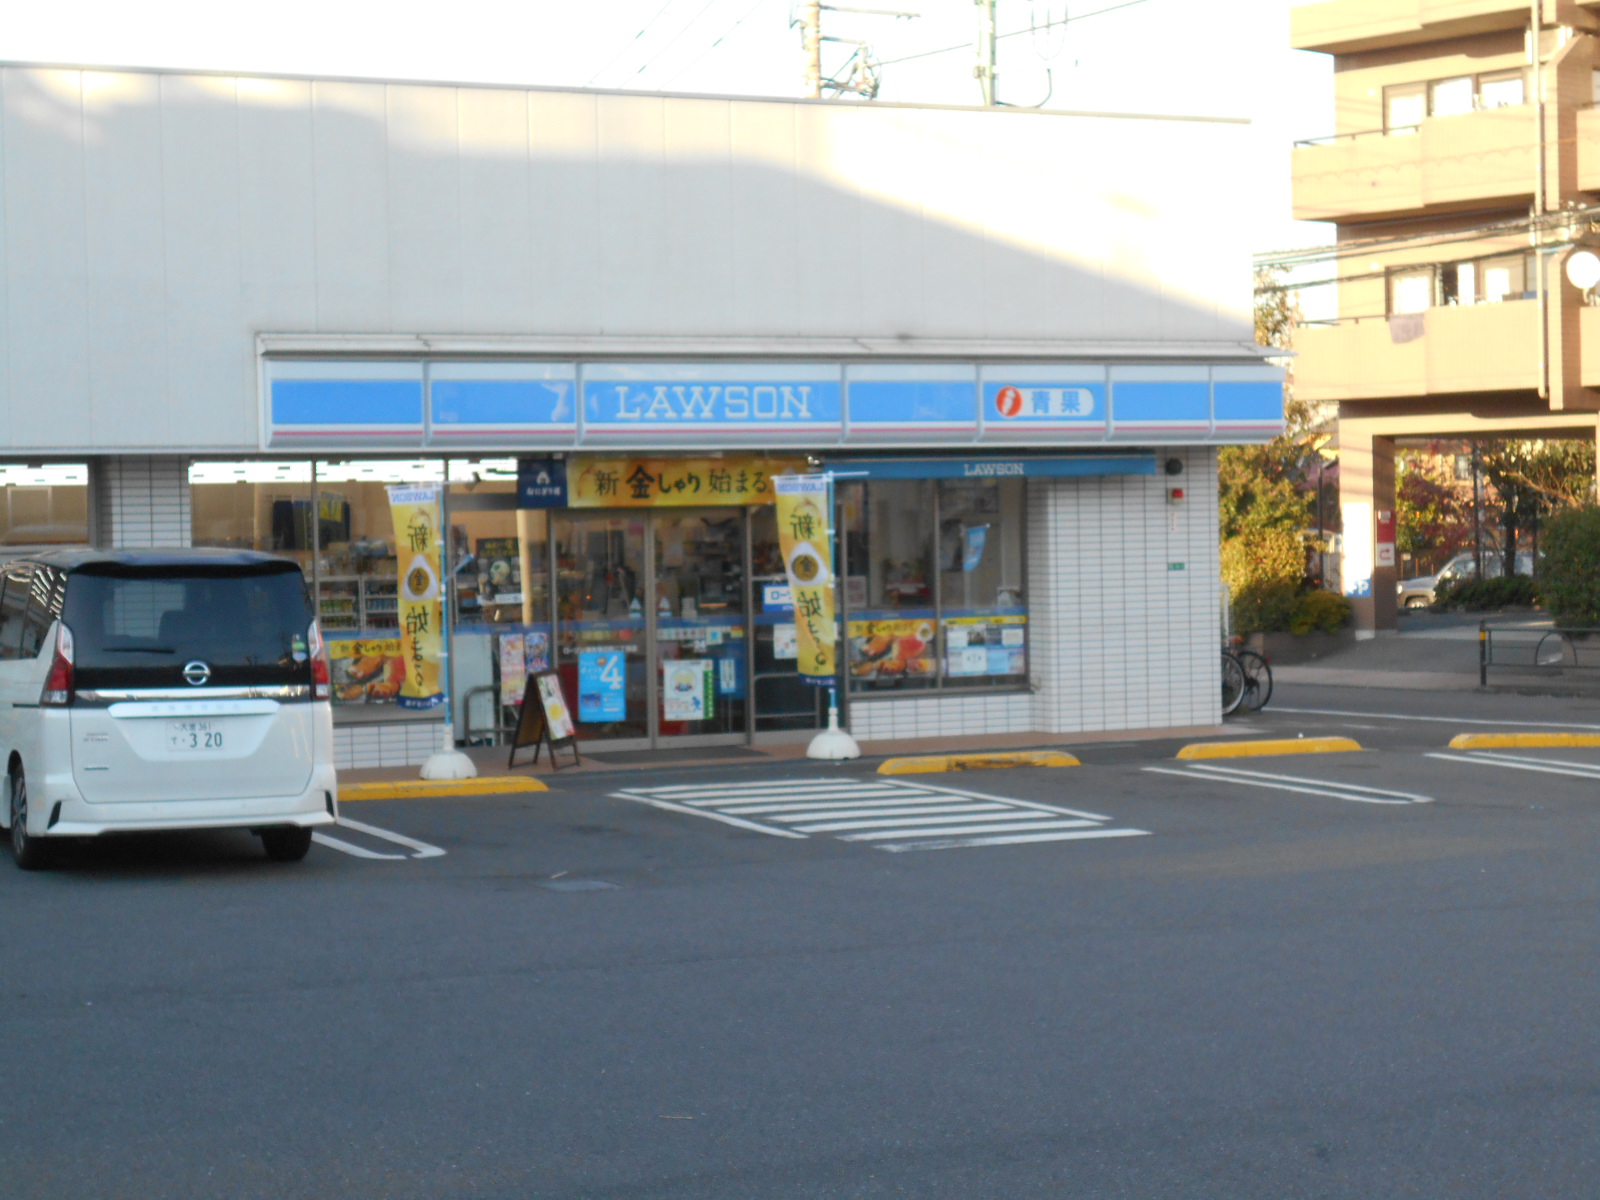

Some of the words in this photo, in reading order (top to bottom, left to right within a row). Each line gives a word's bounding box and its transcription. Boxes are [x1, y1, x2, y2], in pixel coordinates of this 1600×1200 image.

[614, 385, 812, 418] LAWSON
[1032, 390, 1081, 414] 青果
[964, 463, 1025, 476] LAWSON
[602, 656, 623, 690] 4
